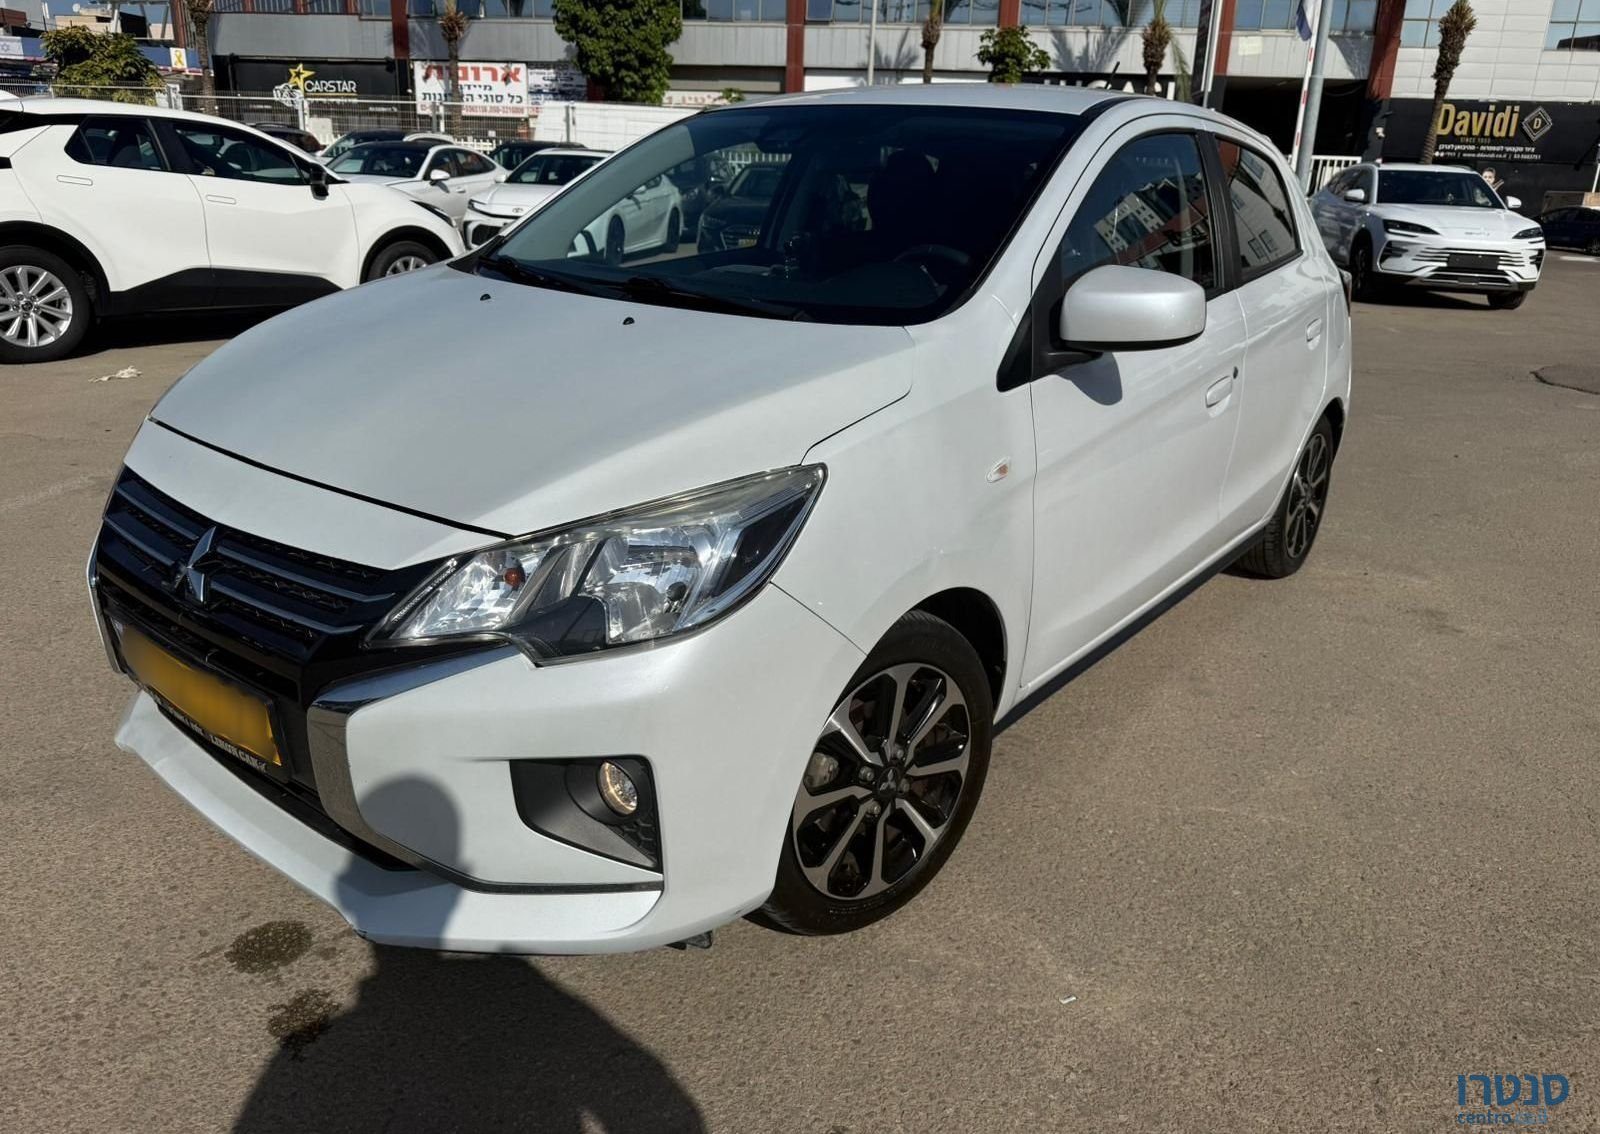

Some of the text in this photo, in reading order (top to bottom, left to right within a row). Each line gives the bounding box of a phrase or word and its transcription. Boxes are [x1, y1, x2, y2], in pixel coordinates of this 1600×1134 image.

[304, 80, 357, 93] CARSTAR
[477, 94, 504, 103] סוגי
[507, 93, 523, 103] כל
[1437, 103, 1520, 138] Davidi
[1533, 117, 1542, 130] D
